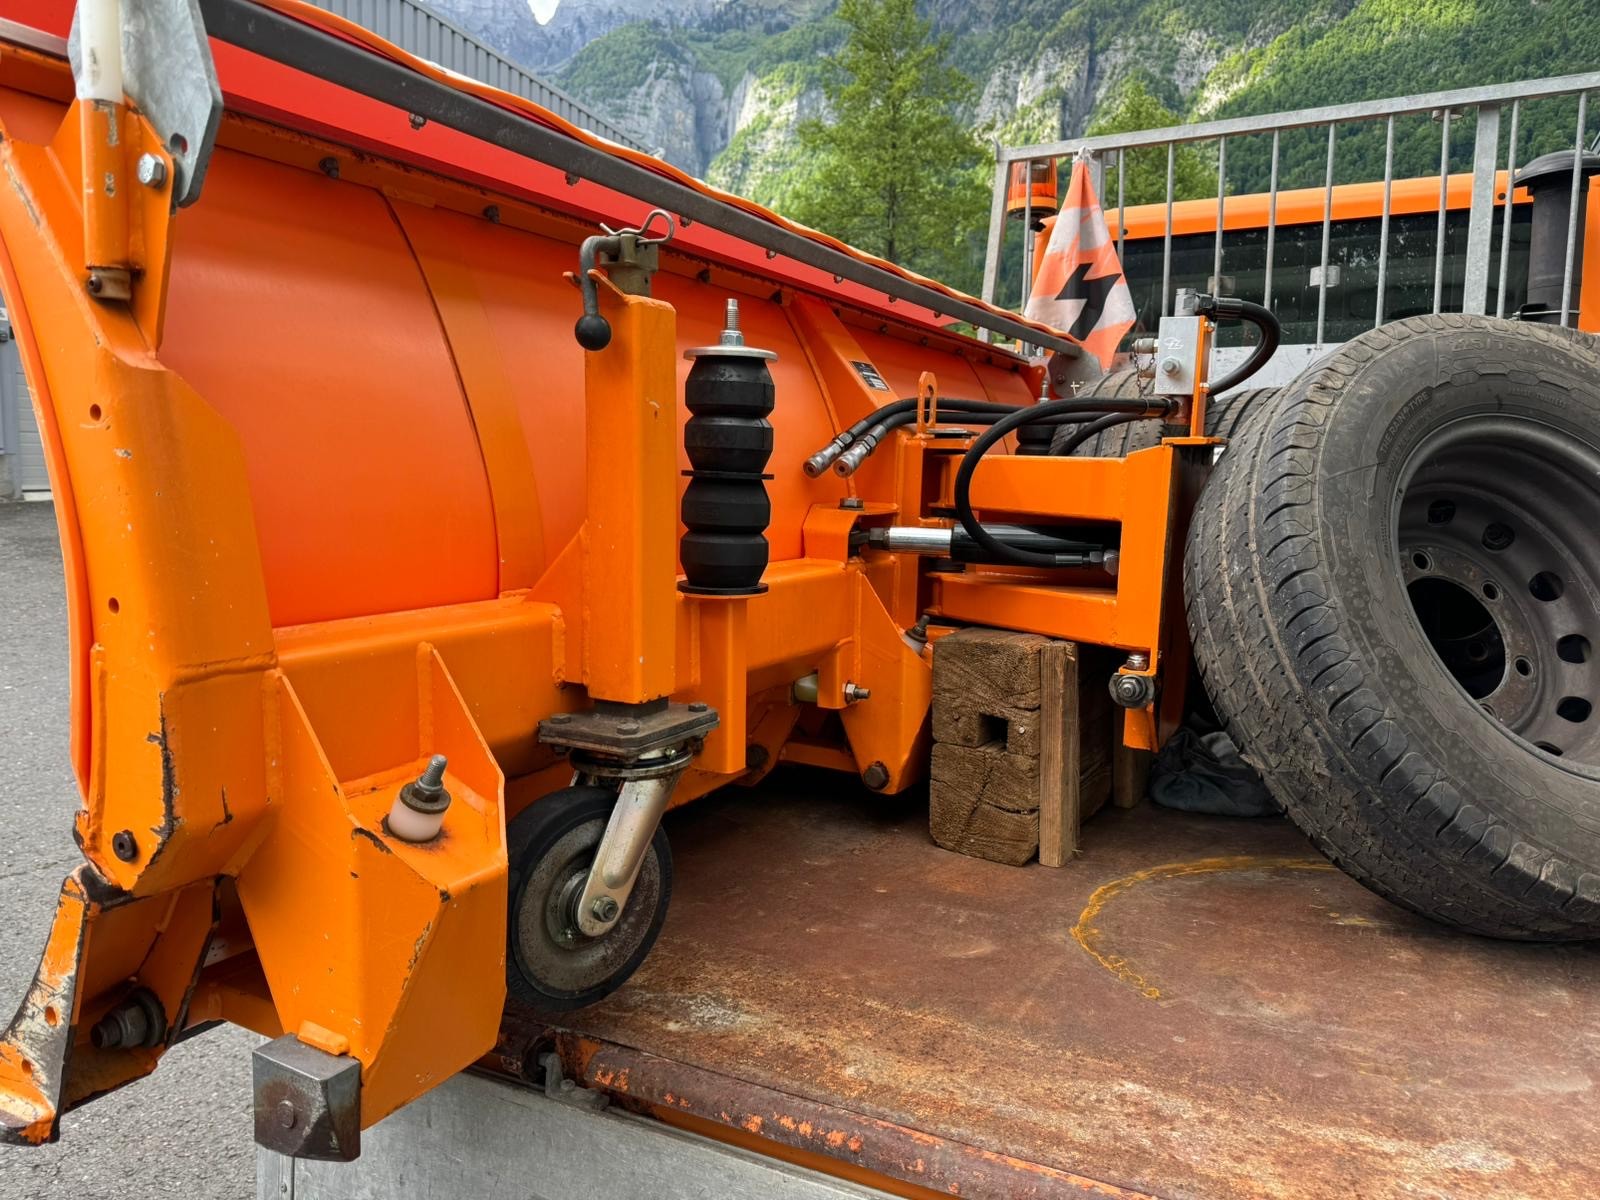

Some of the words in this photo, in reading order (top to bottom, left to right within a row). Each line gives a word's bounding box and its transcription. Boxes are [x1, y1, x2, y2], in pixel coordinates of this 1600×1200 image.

[1379, 432, 1395, 453] THE
[1388, 414, 1408, 435] RAIN
[1407, 391, 1430, 411] TYRE
